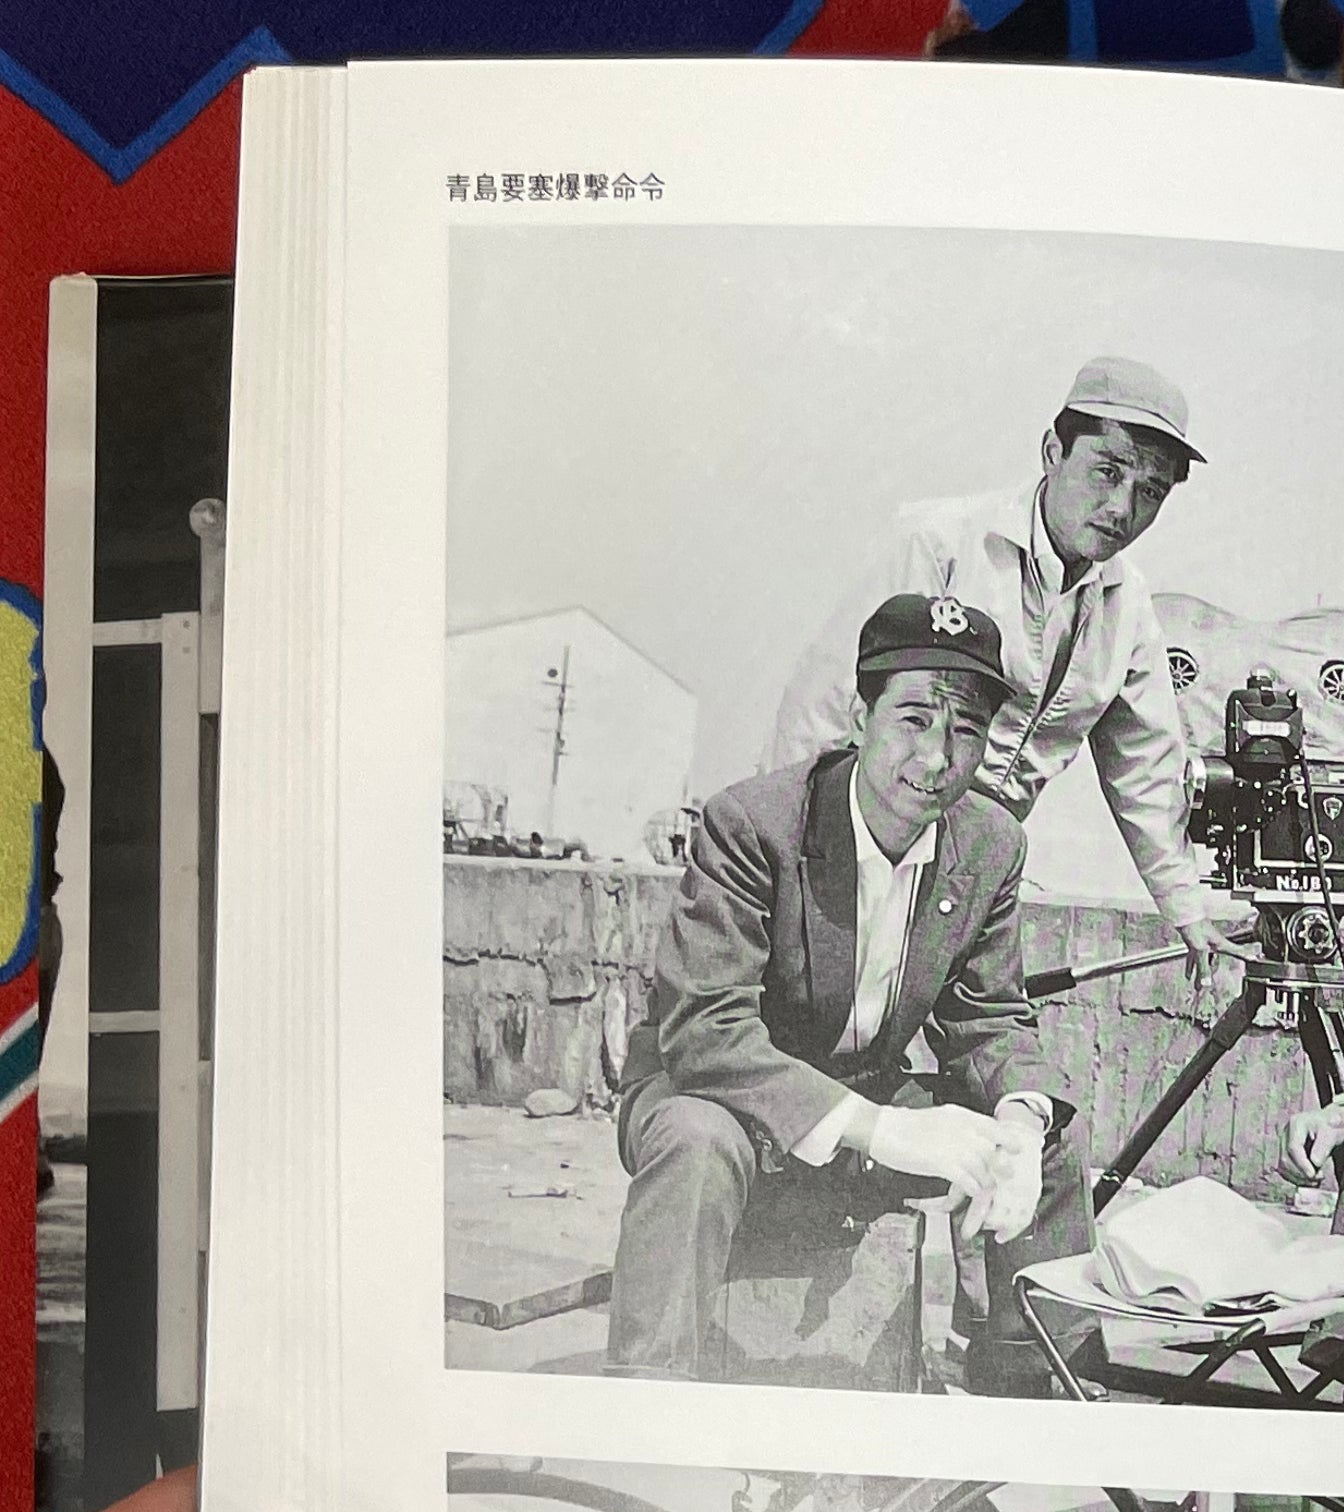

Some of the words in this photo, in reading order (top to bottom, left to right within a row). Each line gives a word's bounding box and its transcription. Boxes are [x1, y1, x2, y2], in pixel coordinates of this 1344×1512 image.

[446, 172, 665, 202] 青島要塞爆撃命令
